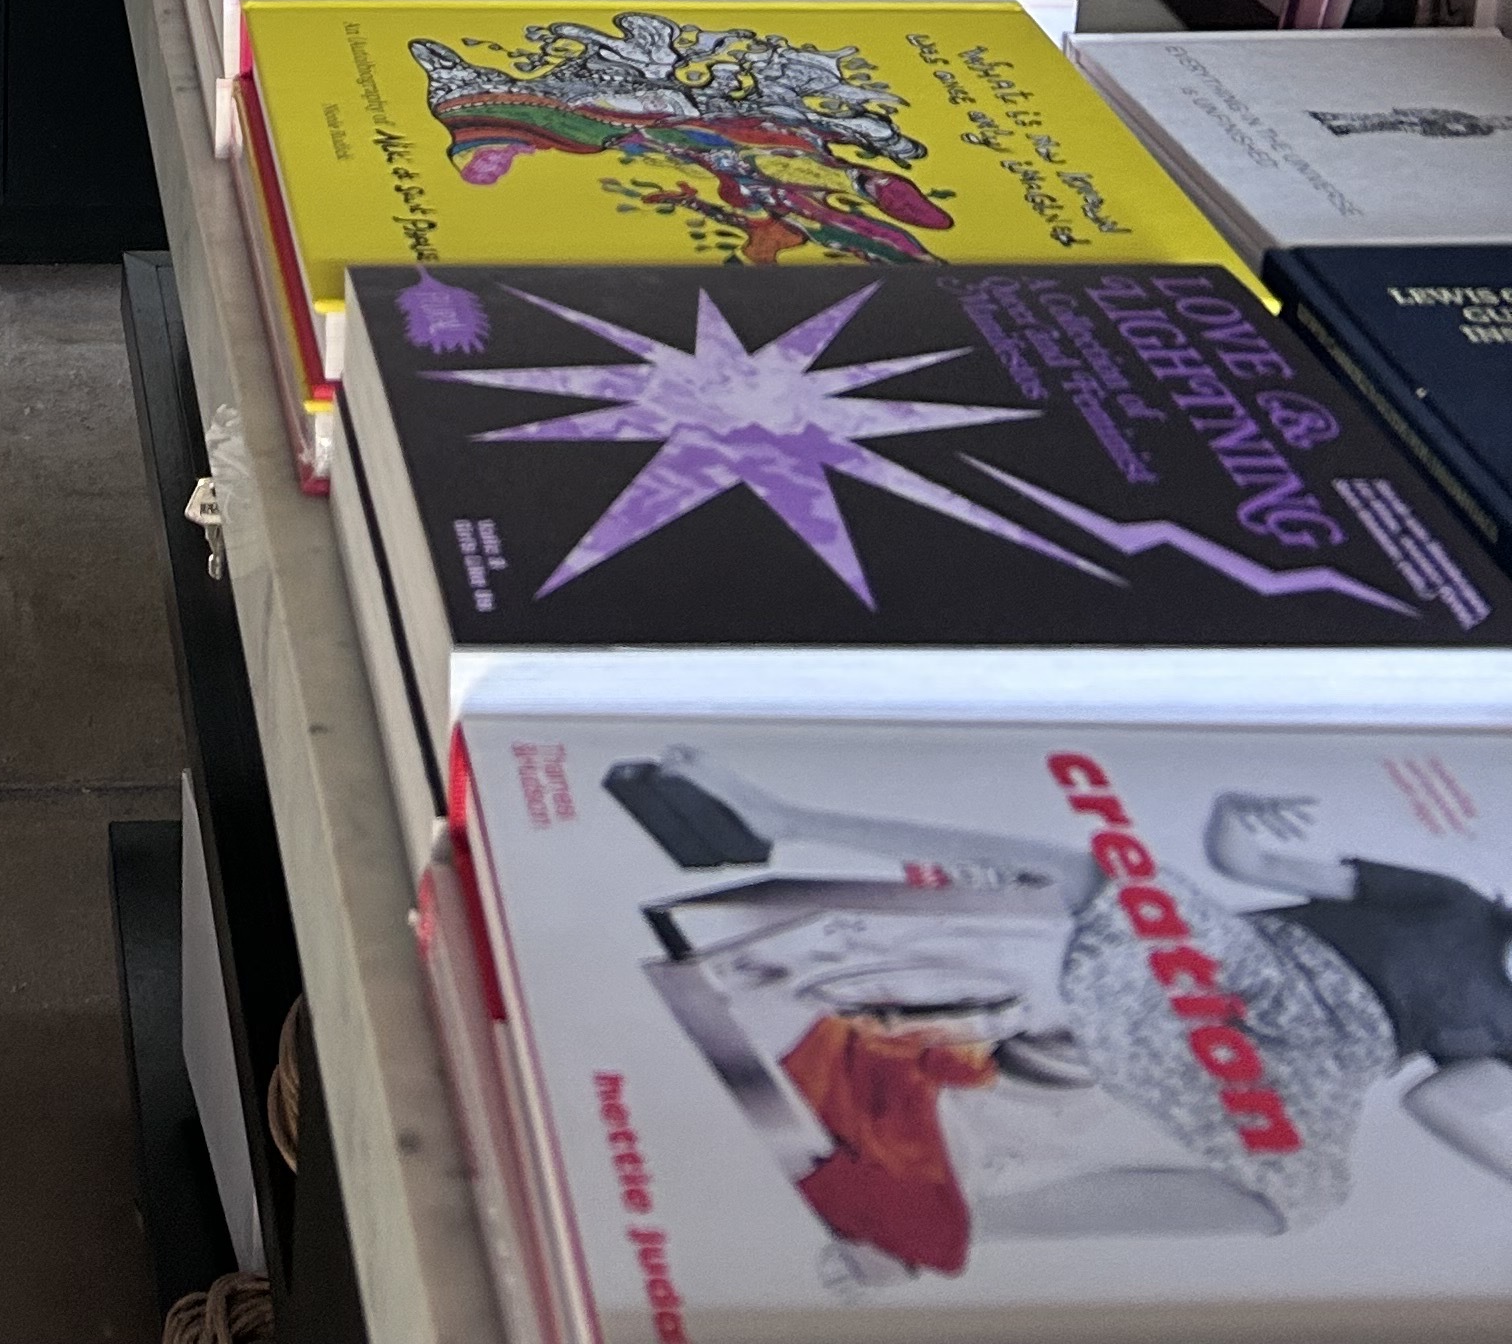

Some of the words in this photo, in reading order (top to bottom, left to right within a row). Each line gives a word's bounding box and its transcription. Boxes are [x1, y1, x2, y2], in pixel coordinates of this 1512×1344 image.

[1086, 275, 1350, 550] LIGHTNING
[1150, 275, 1296, 381] LOVE
[1255, 389, 1341, 452] &
[1045, 749, 1305, 1159] creation
